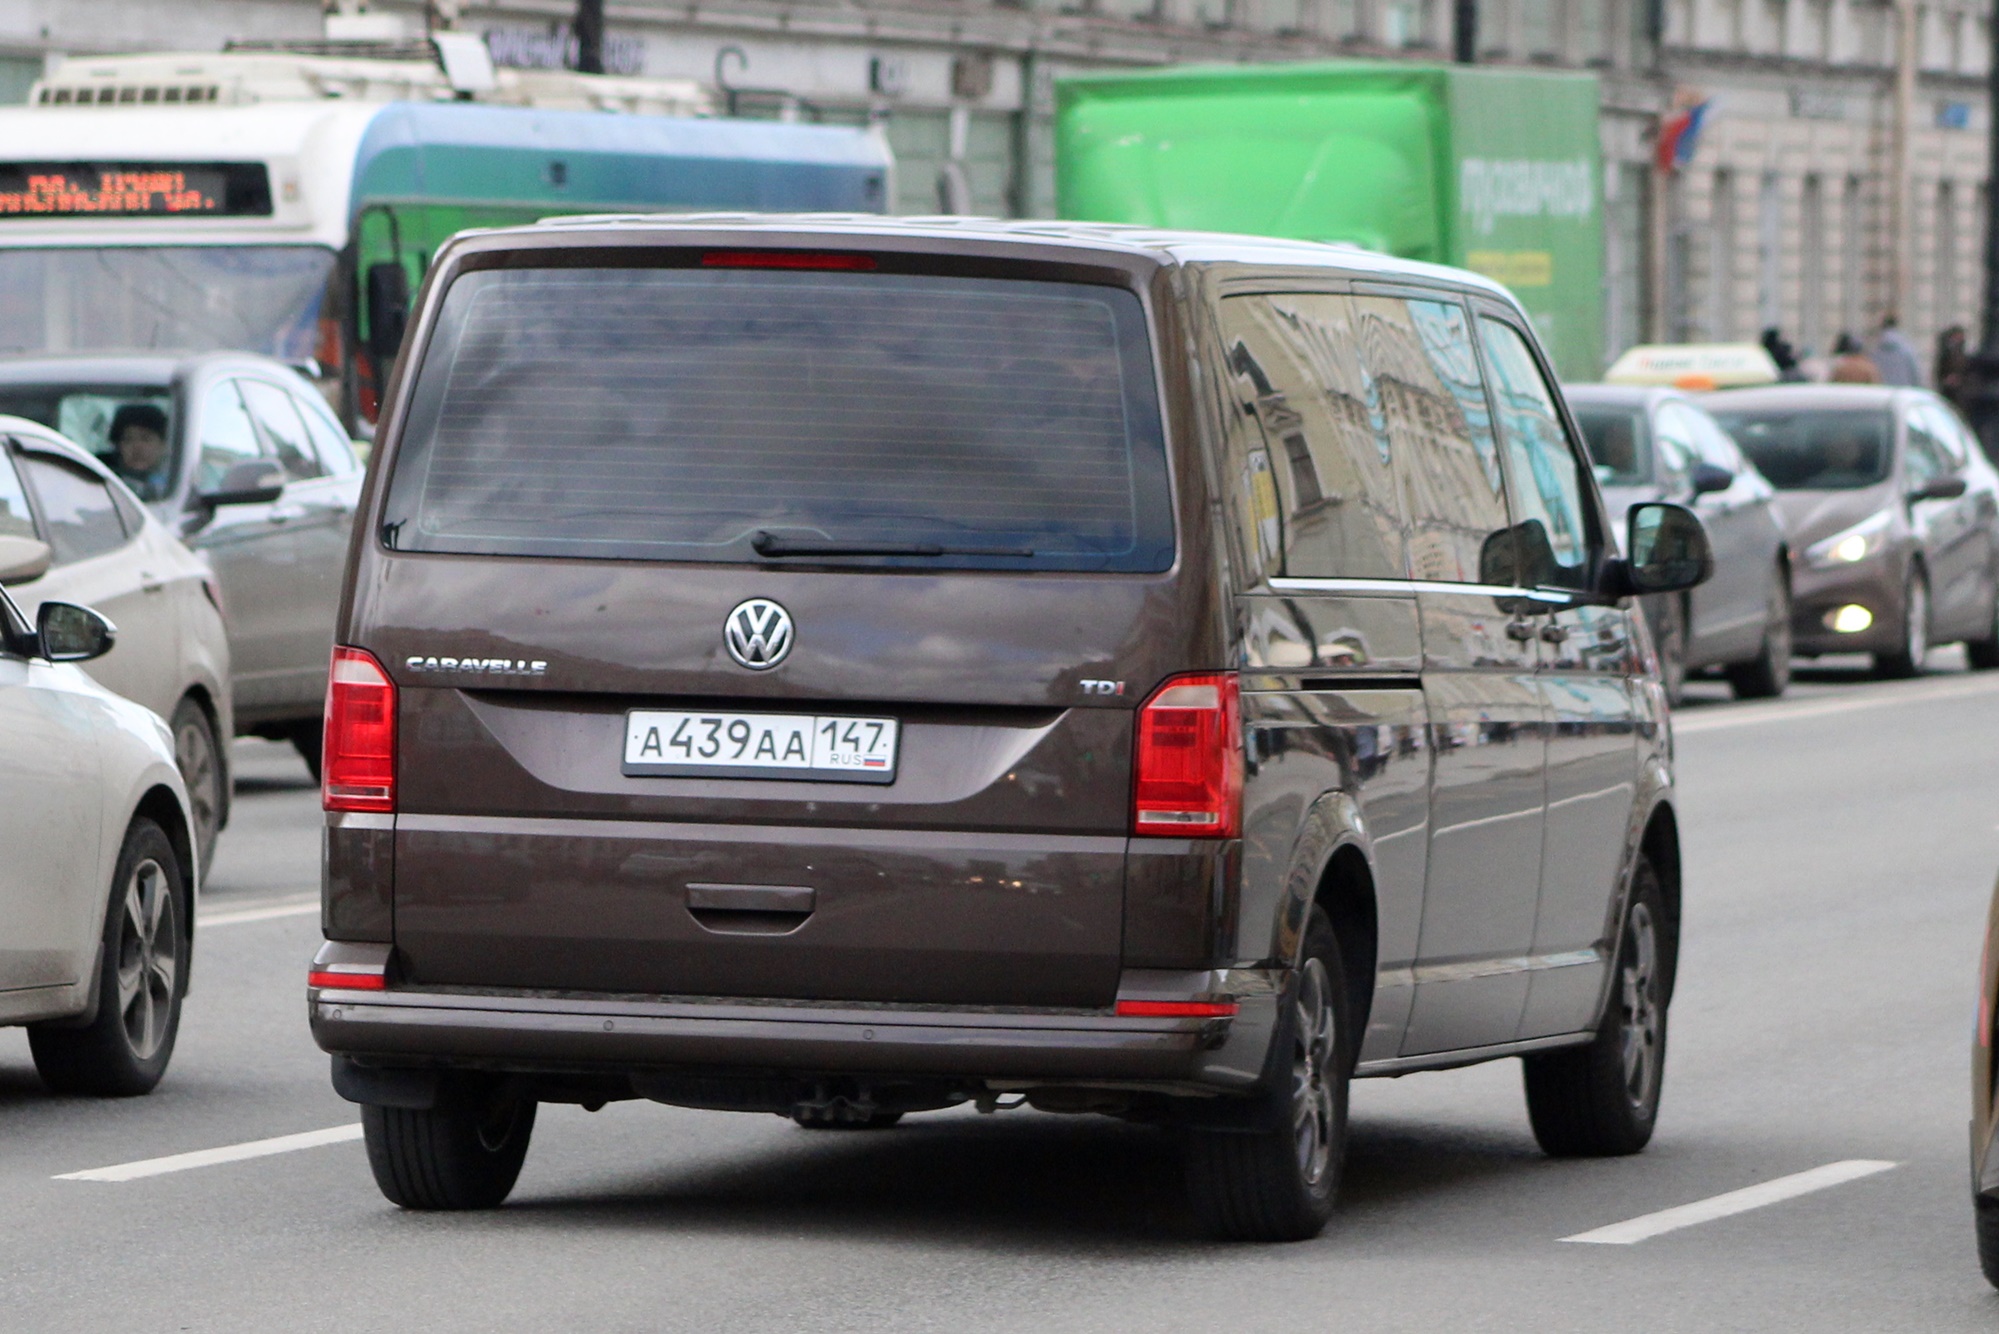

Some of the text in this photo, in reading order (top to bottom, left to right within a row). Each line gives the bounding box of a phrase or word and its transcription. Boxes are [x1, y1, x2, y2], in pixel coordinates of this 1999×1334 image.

[405, 656, 548, 675] CARAVELLE
[1080, 680, 1125, 695] TDI
[640, 717, 884, 762] А439АА 147
[830, 753, 861, 765] RUS
